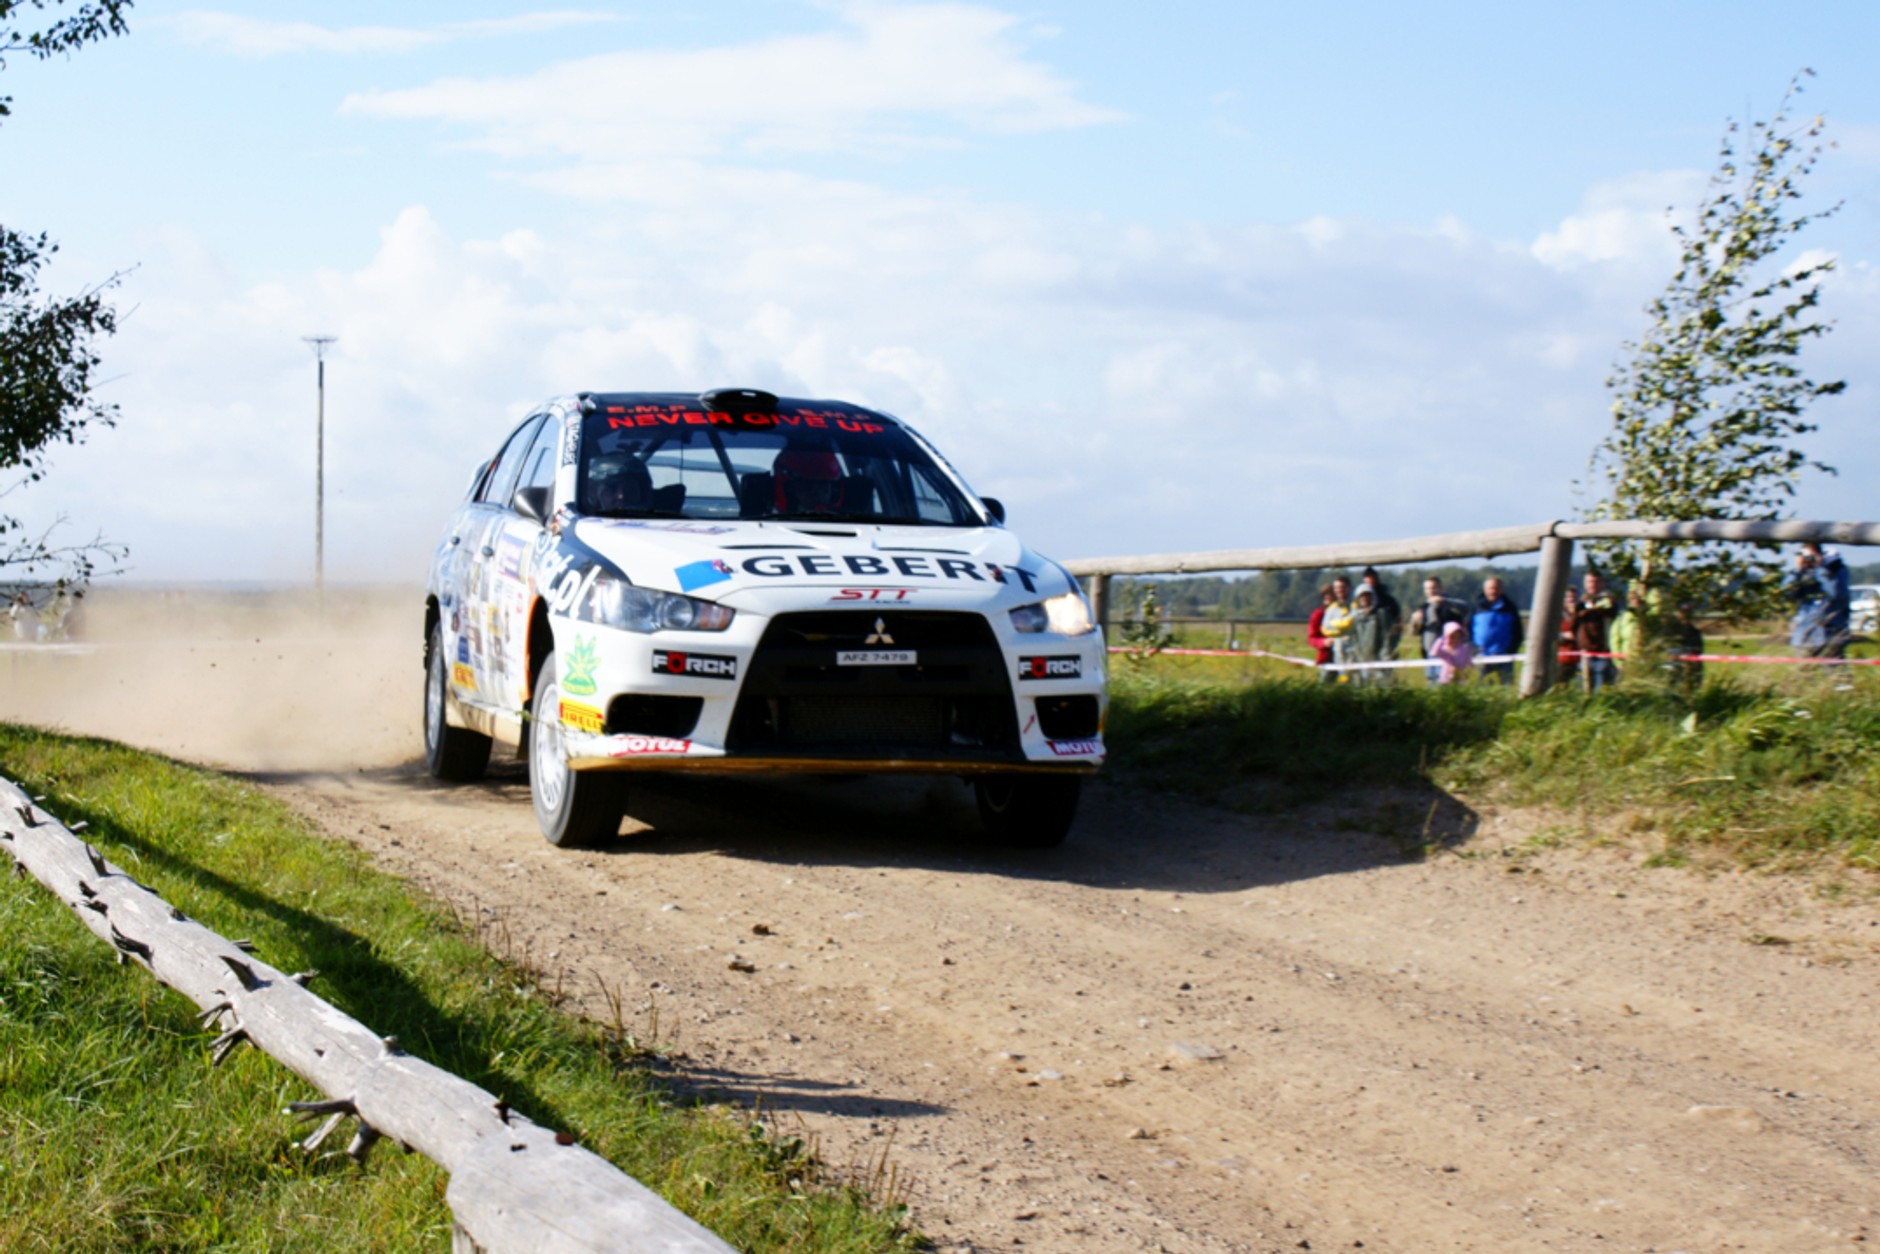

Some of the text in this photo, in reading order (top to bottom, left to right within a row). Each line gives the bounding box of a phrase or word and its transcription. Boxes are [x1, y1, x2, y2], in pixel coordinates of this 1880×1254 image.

[607, 411, 884, 434] NEVER GIVE UP
[742, 555, 1038, 594] GEBERIT
[830, 588, 918, 601] STT
